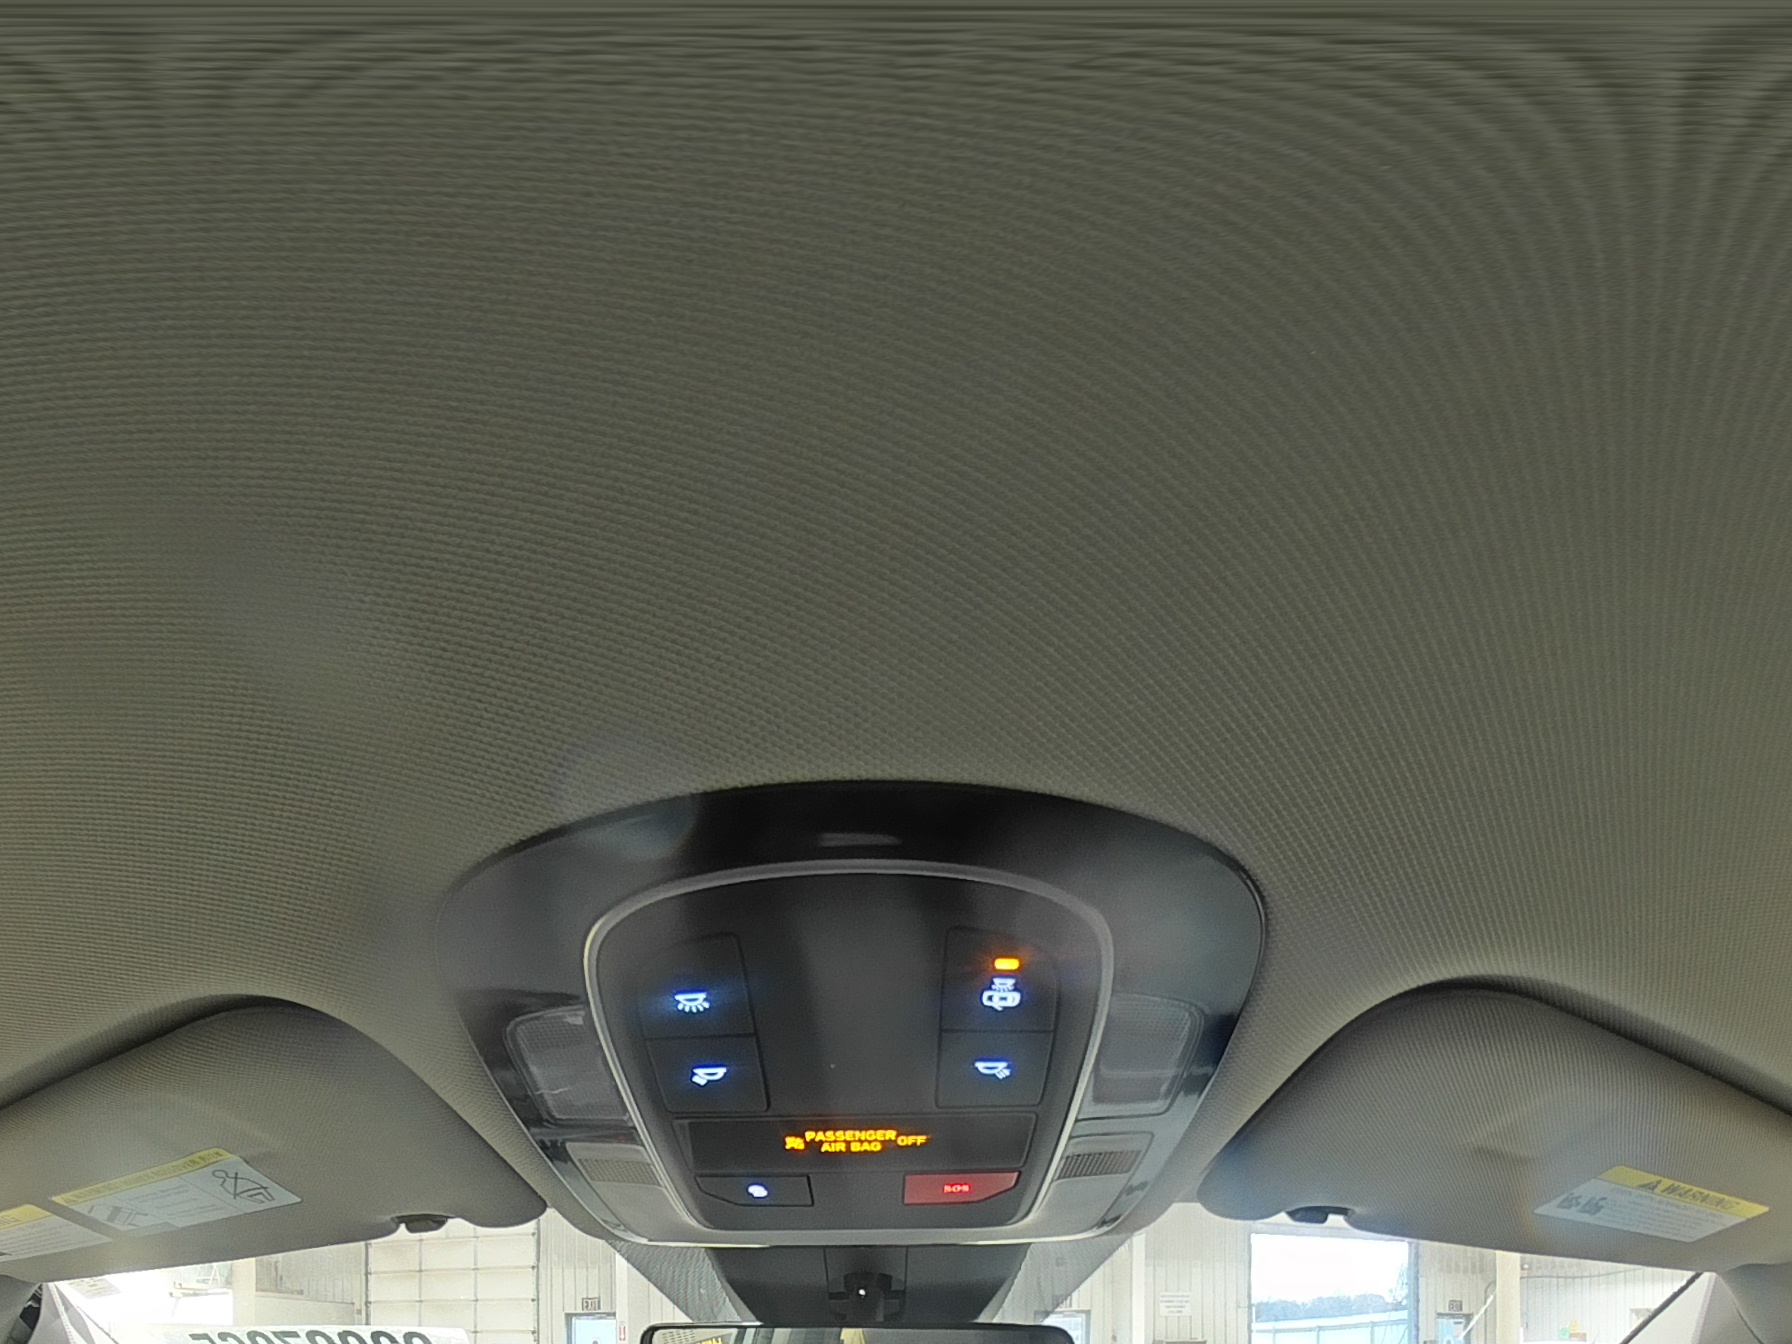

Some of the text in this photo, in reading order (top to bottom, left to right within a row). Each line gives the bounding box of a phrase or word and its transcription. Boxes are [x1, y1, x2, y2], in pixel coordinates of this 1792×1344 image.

[805, 1129, 897, 1142] PASSENGER
[897, 1134, 927, 1146] OFF
[820, 1141, 883, 1153] AIR BAG
[943, 1183, 970, 1194] SOS
[1662, 1182, 1741, 1210] WARNING
